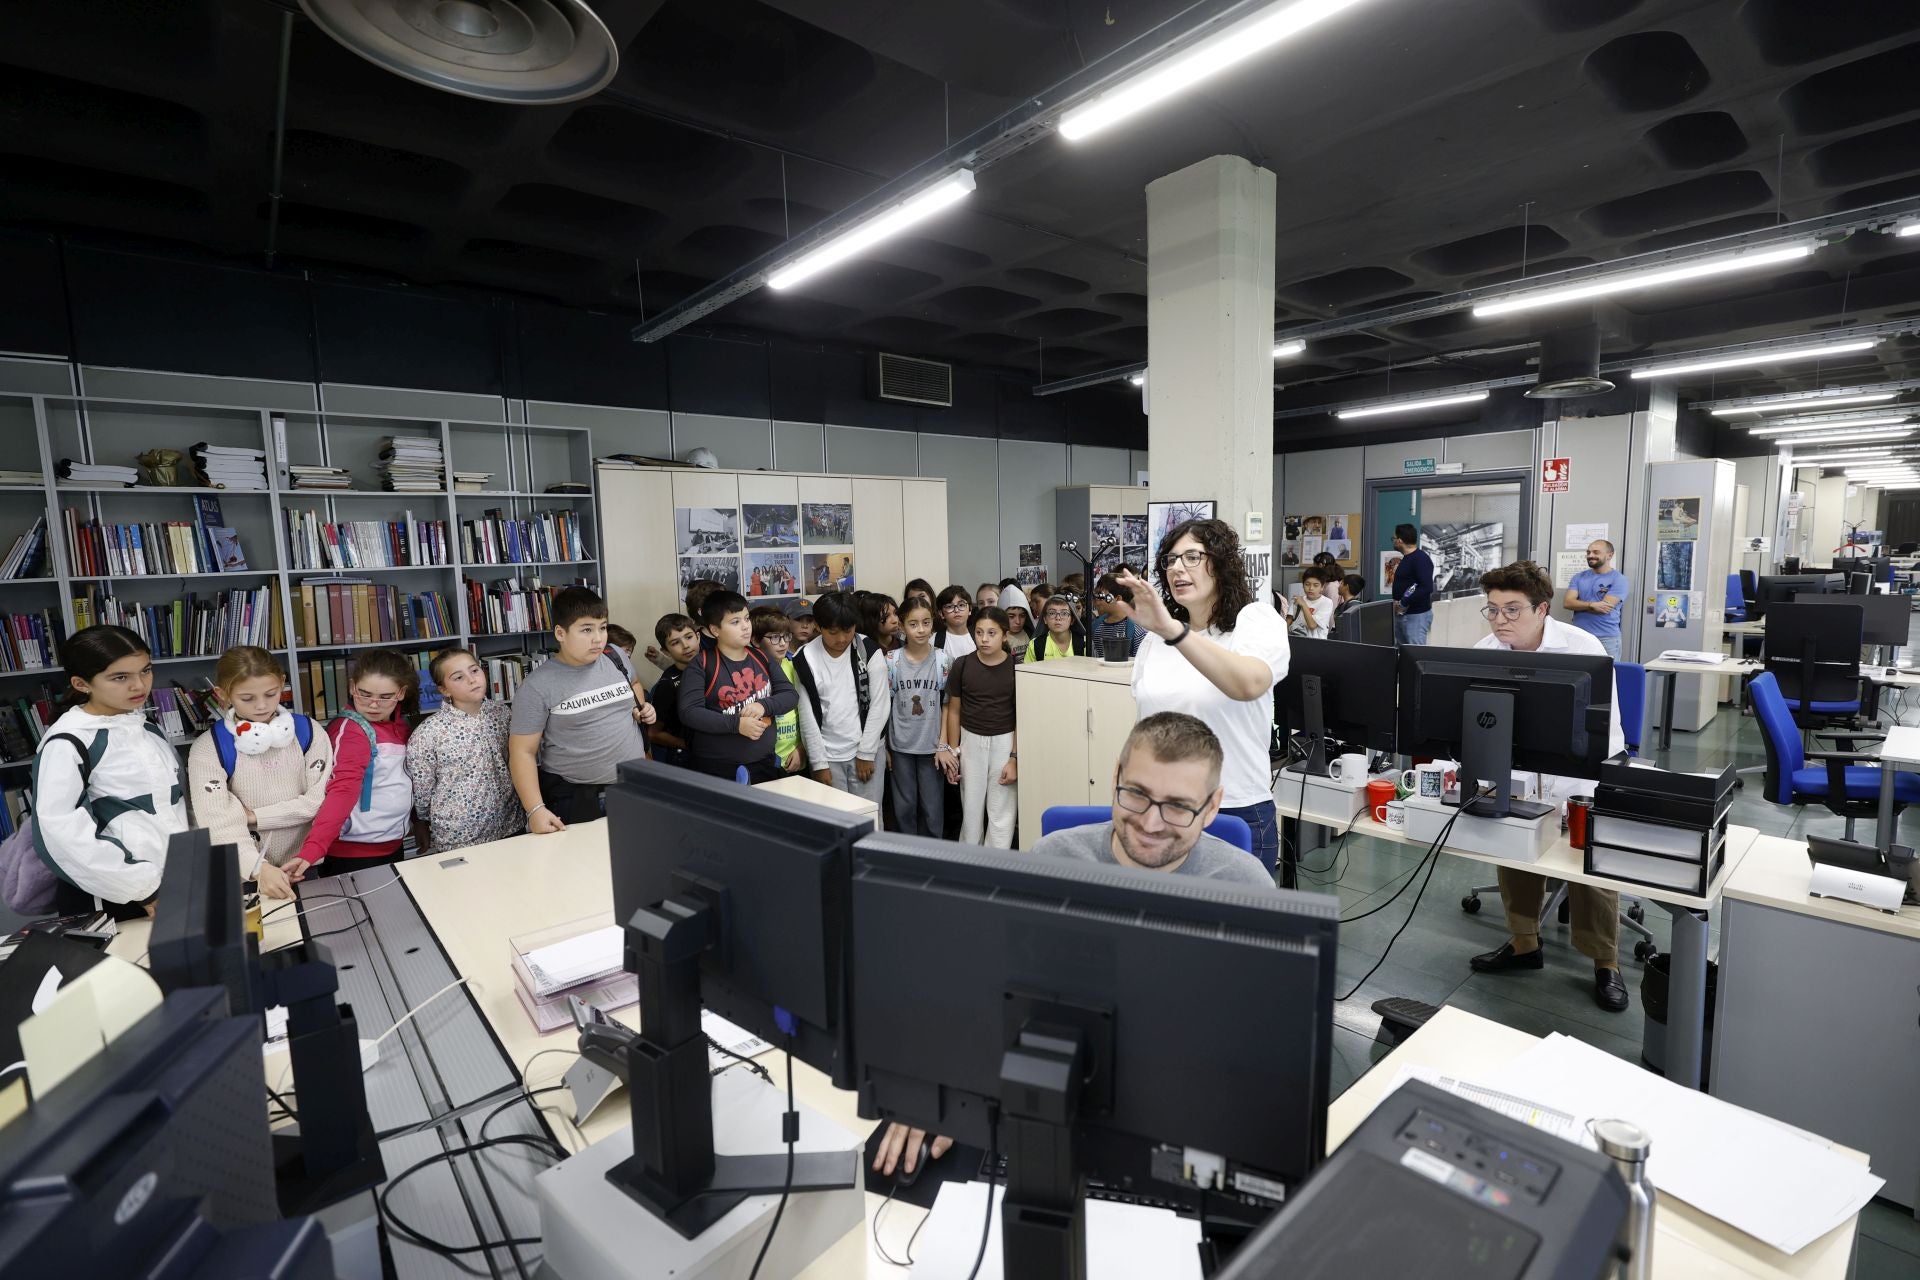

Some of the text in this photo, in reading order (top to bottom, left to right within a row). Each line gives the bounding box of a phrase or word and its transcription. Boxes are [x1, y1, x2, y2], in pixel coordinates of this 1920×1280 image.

[560, 685, 630, 711] CALVIN KLEIN JEA
[776, 723, 796, 735] MURC
[1477, 711, 1497, 729] hp
